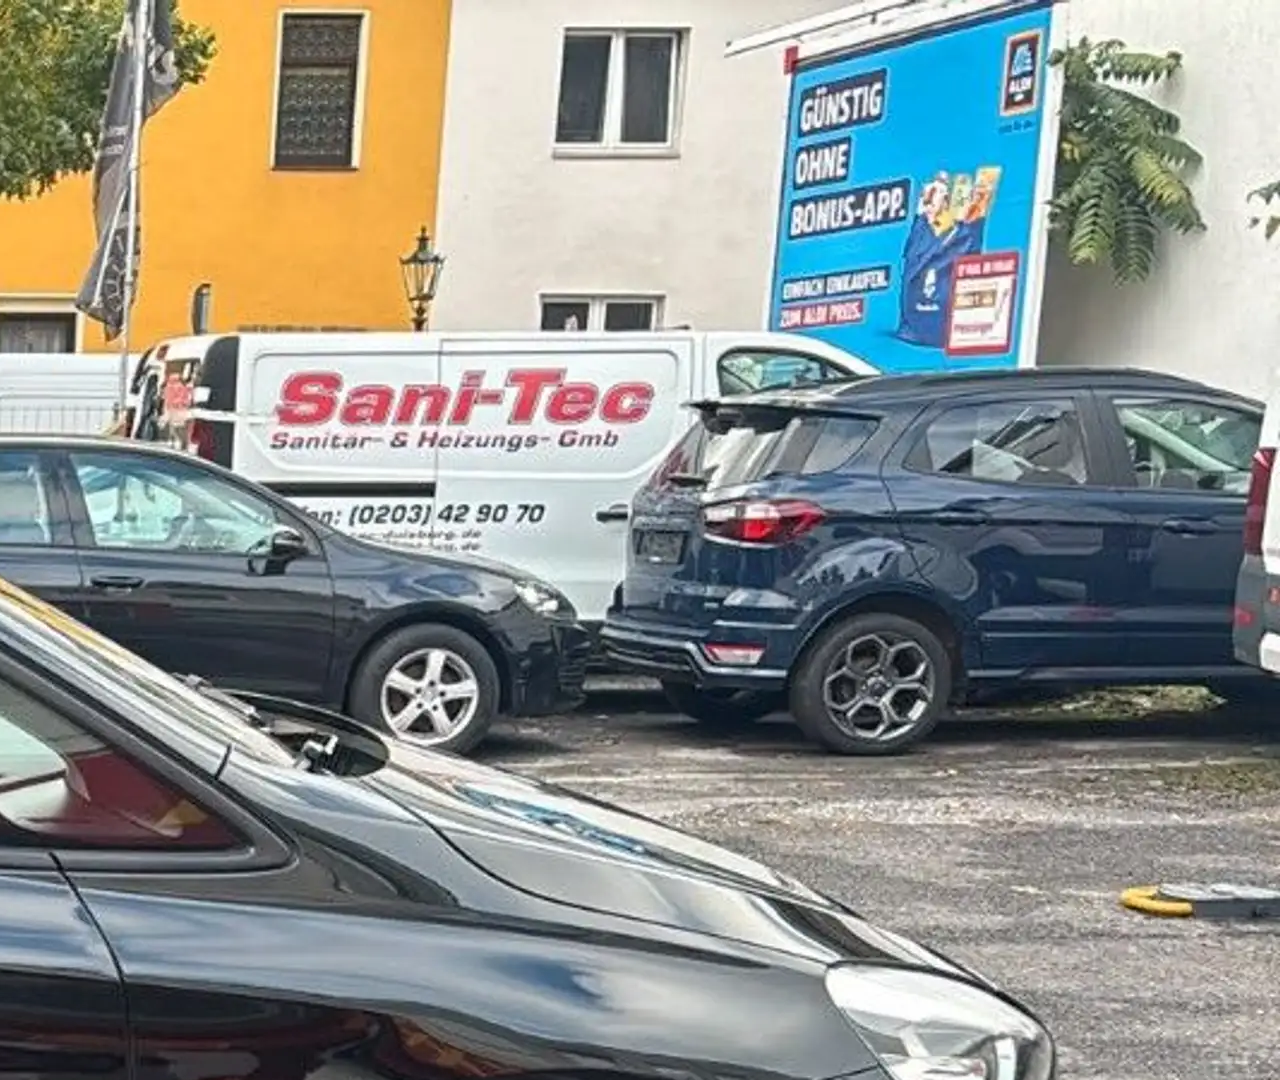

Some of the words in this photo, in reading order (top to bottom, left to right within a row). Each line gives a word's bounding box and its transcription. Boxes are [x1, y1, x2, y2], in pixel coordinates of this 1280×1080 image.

[799, 81, 883, 133] GÜNSTIG
[795, 143, 849, 185] OHNE
[790, 186, 906, 237] BONUS-APP.
[274, 366, 656, 427] Sani-Tec
[389, 430, 409, 450] &
[558, 428, 620, 449] Gmb
[348, 503, 431, 527] (0203)
[436, 503, 470, 524] 42
[475, 503, 509, 524] 90
[514, 503, 546, 524] 70
